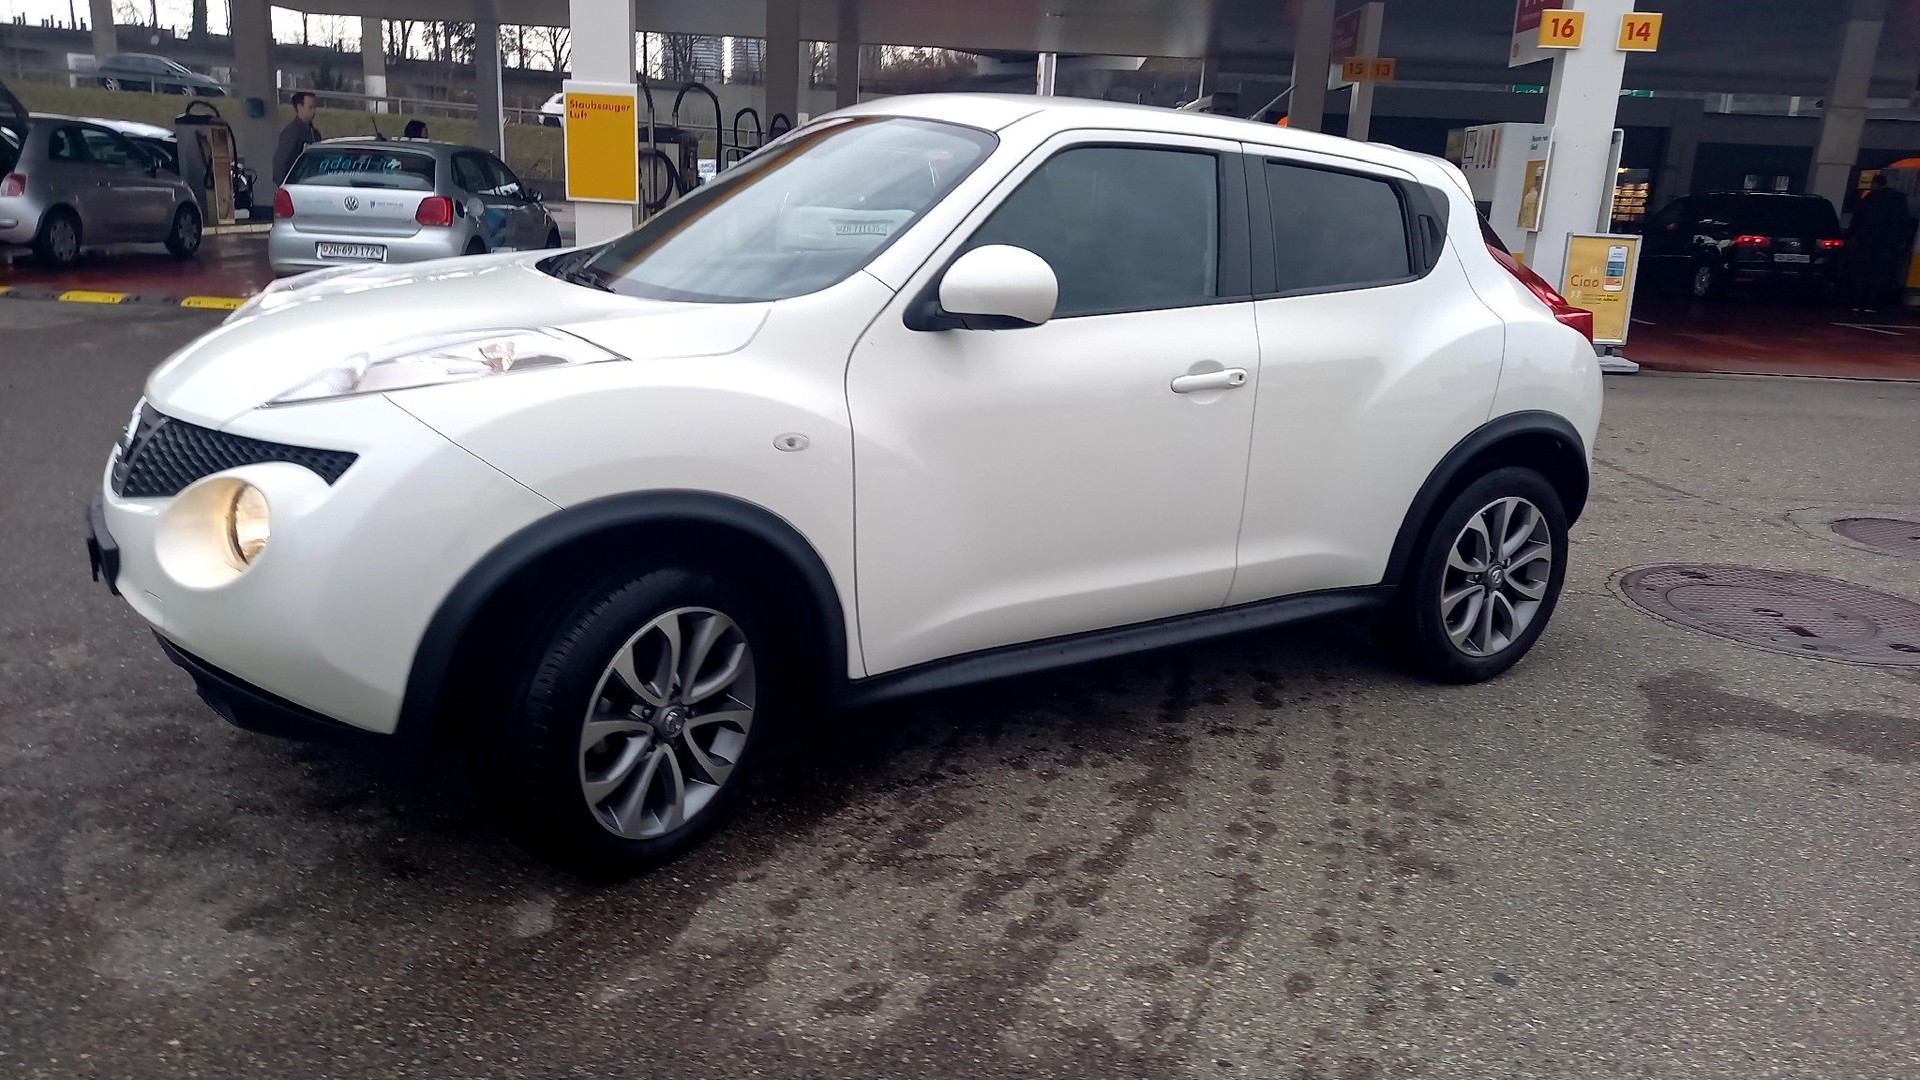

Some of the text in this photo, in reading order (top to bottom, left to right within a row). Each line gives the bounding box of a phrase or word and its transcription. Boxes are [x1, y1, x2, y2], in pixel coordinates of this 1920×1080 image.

[1551, 18, 1575, 38] 16
[1626, 21, 1651, 41] 14
[1349, 62, 1364, 75] 15
[1376, 63, 1391, 76] 13
[569, 99, 631, 113] Staubsauger
[569, 110, 588, 119] Luft
[1570, 274, 1600, 288] Ciao
